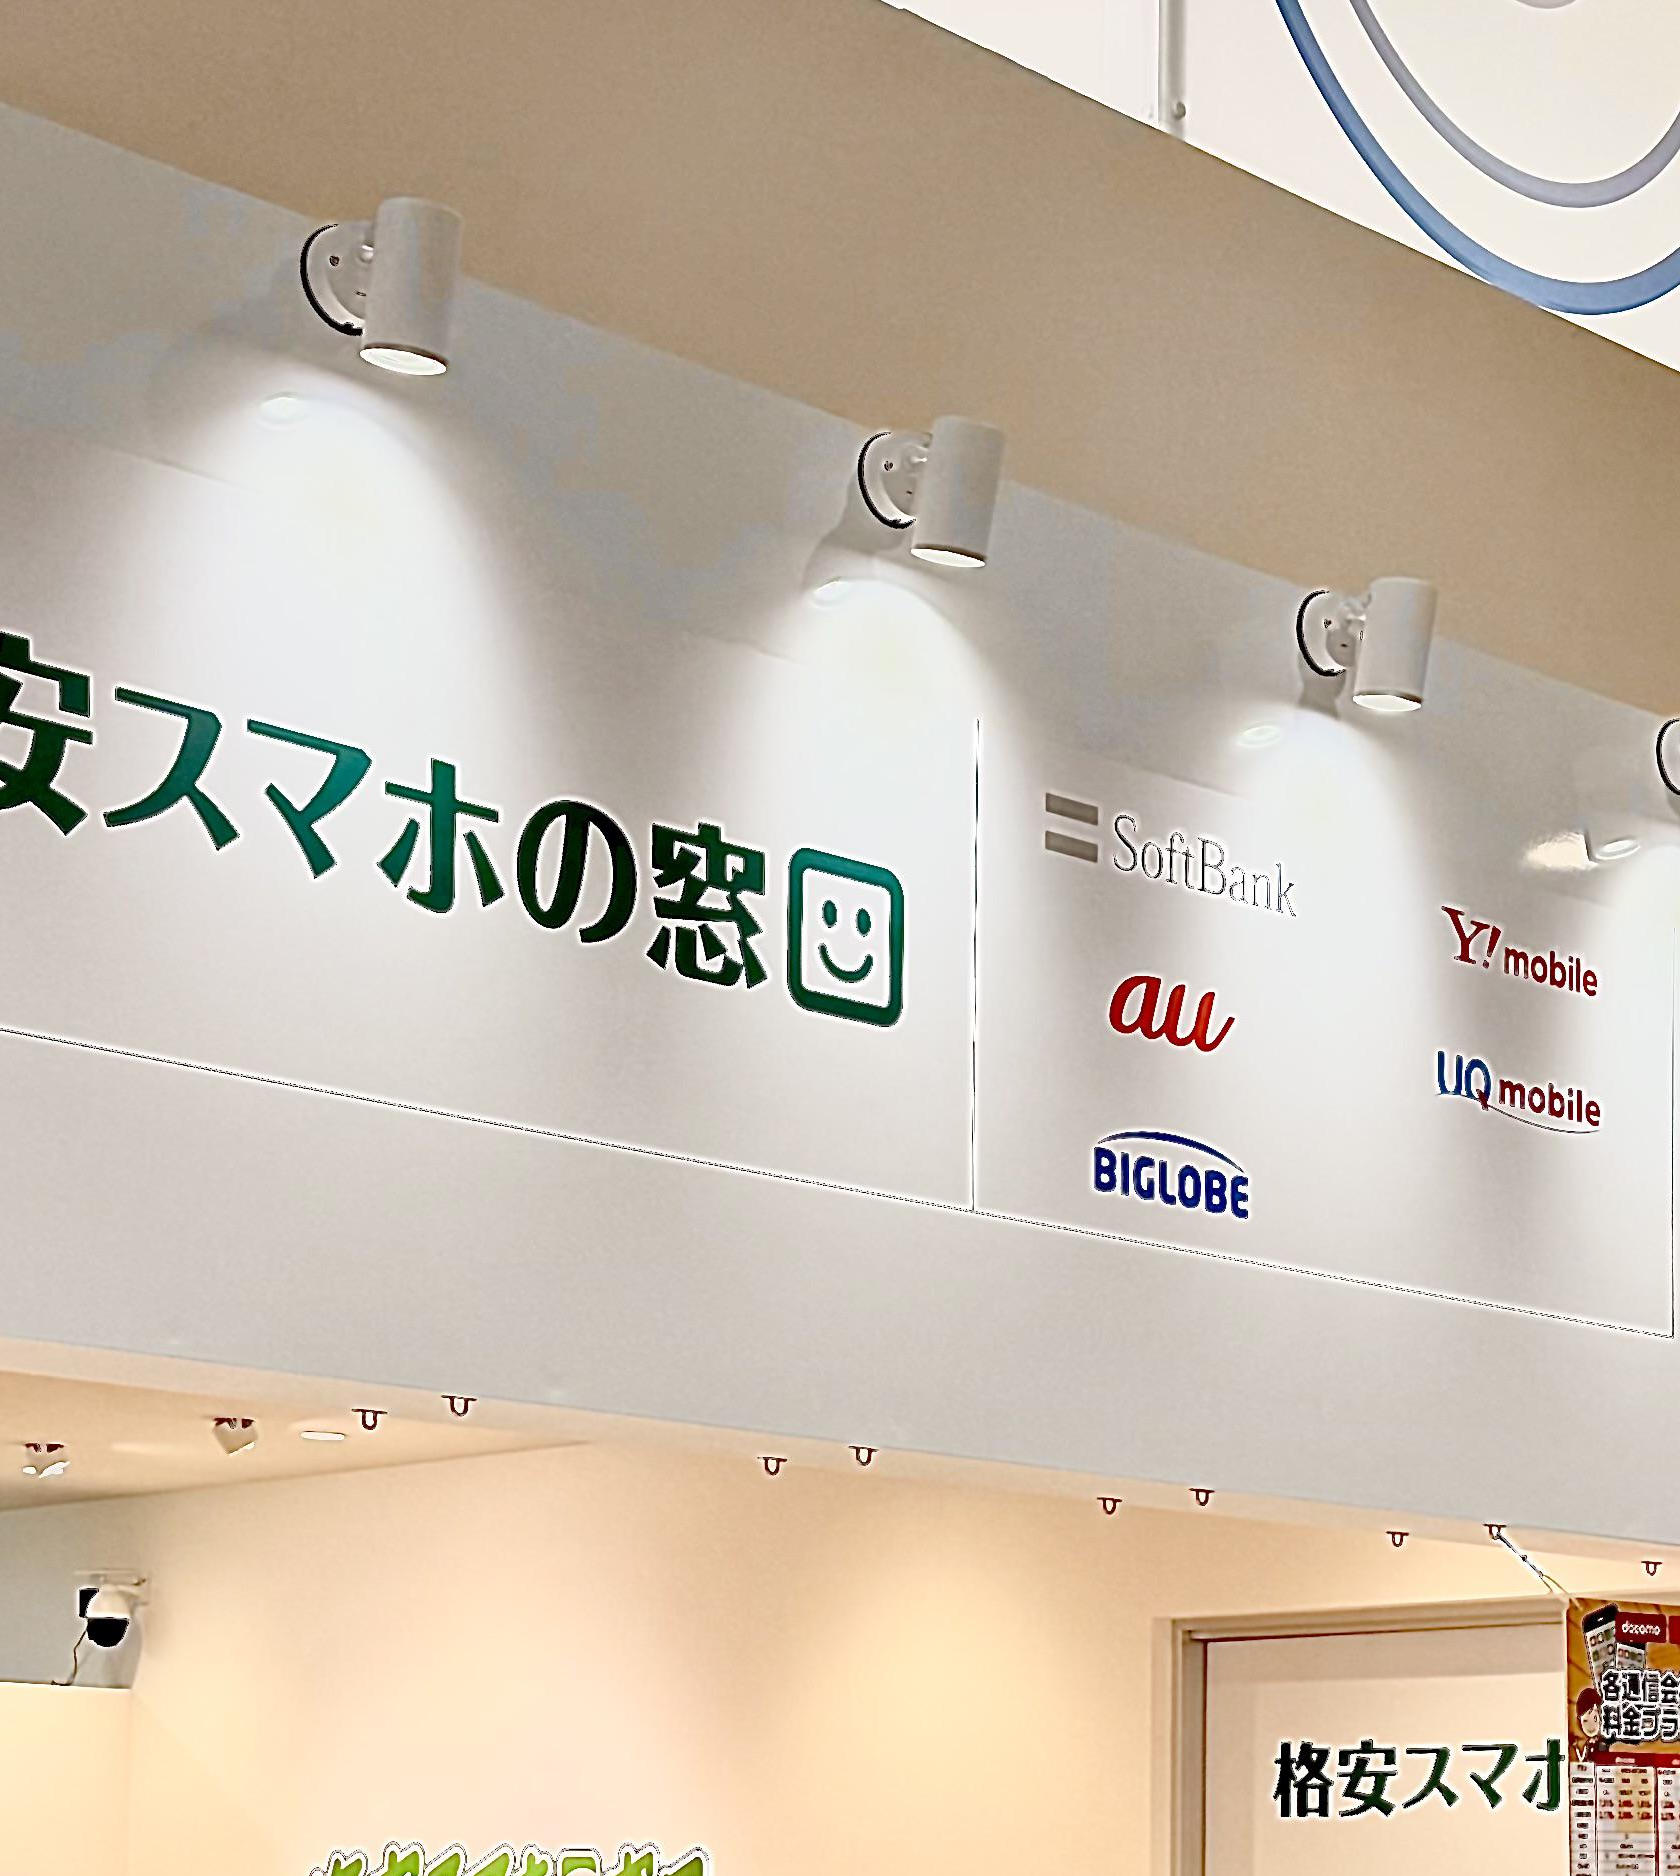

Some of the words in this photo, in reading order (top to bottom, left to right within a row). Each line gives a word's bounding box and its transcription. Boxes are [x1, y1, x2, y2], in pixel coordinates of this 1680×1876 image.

[1113, 813, 1297, 917] SoftBank
[1109, 974, 1235, 1052] au
[1437, 1050, 1491, 1108] UQ
[1498, 1075, 1601, 1127] mobile
[1093, 1146, 1249, 1219] BIGLOBE
[1621, 1620, 1661, 1636] docomo
